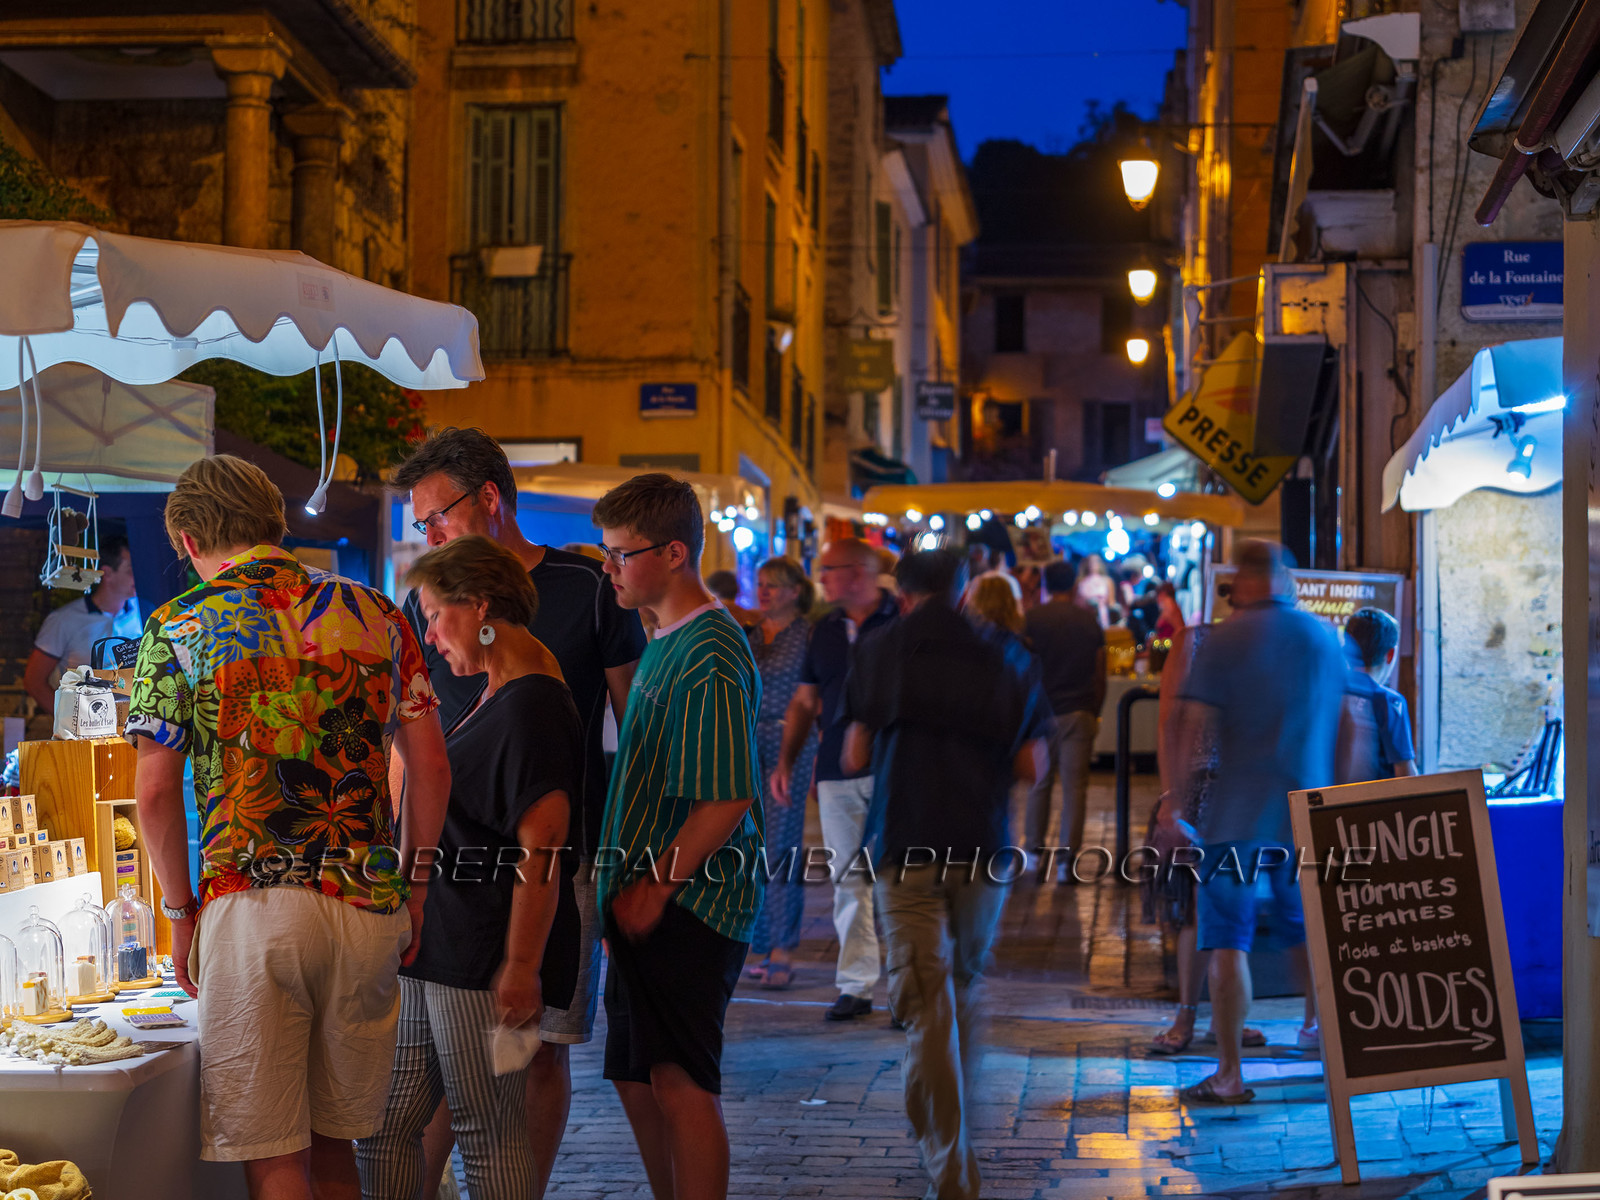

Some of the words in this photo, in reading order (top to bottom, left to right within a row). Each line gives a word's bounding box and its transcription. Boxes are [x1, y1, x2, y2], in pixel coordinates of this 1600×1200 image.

[1503, 249, 1531, 263] Rue
[1469, 270, 1486, 284] de
[1489, 270, 1502, 284] la
[1505, 270, 1564, 284] Fontaine
[1178, 405, 1270, 488] PRESSE
[1329, 584, 1376, 599] INDIEN
[1330, 811, 1464, 867] JUNGLE
[1337, 877, 1458, 912] HOMMES
[1342, 905, 1455, 932] FEMMES
[1338, 943, 1381, 962] Mode
[1389, 938, 1408, 954] et
[1412, 932, 1472, 952] baskets
[1343, 967, 1494, 1032] SOLDES
